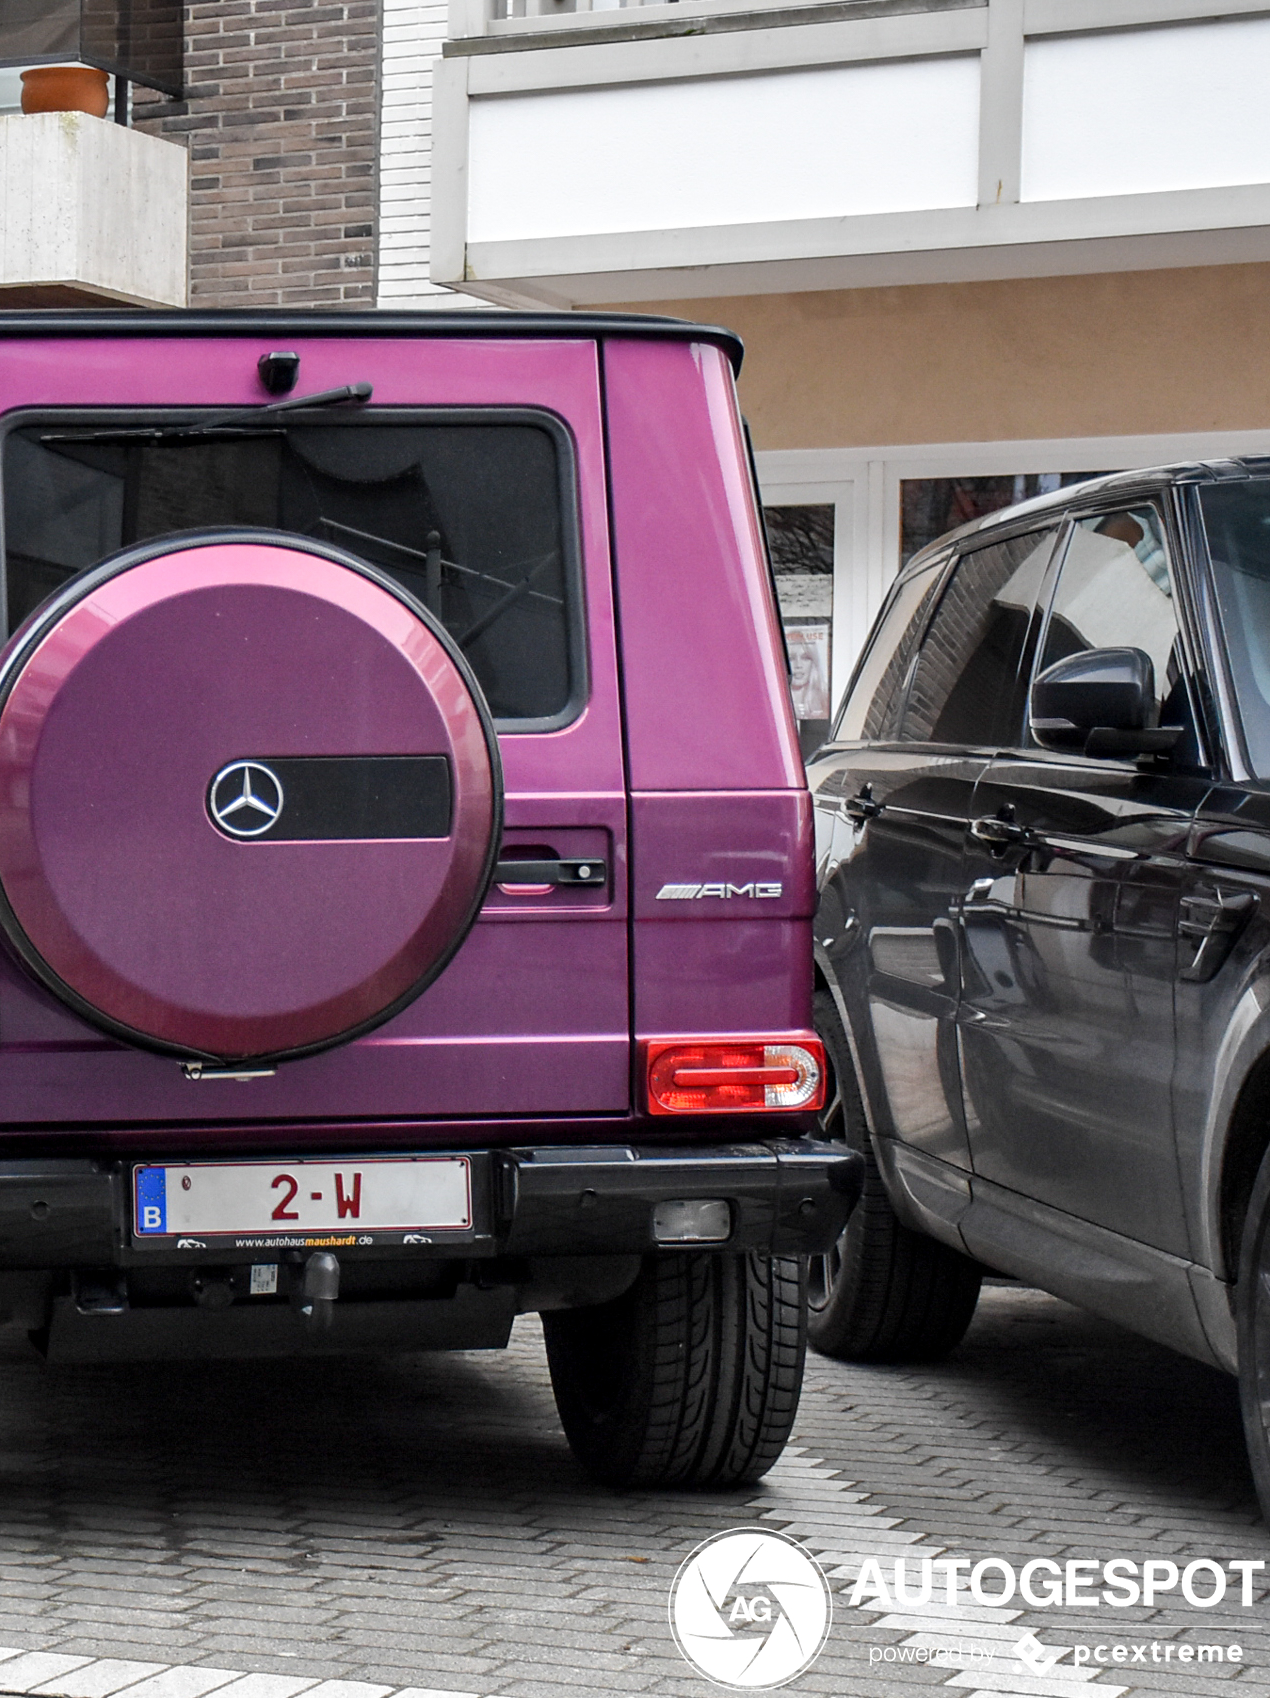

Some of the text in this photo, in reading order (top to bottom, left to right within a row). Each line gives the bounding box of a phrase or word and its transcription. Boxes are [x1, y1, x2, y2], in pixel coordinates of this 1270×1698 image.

[696, 883, 782, 899] AMG
[271, 1172, 363, 1220] 2-W
[144, 1206, 162, 1228] B
[235, 1235, 374, 1247] www.autohausmaushardt.de
